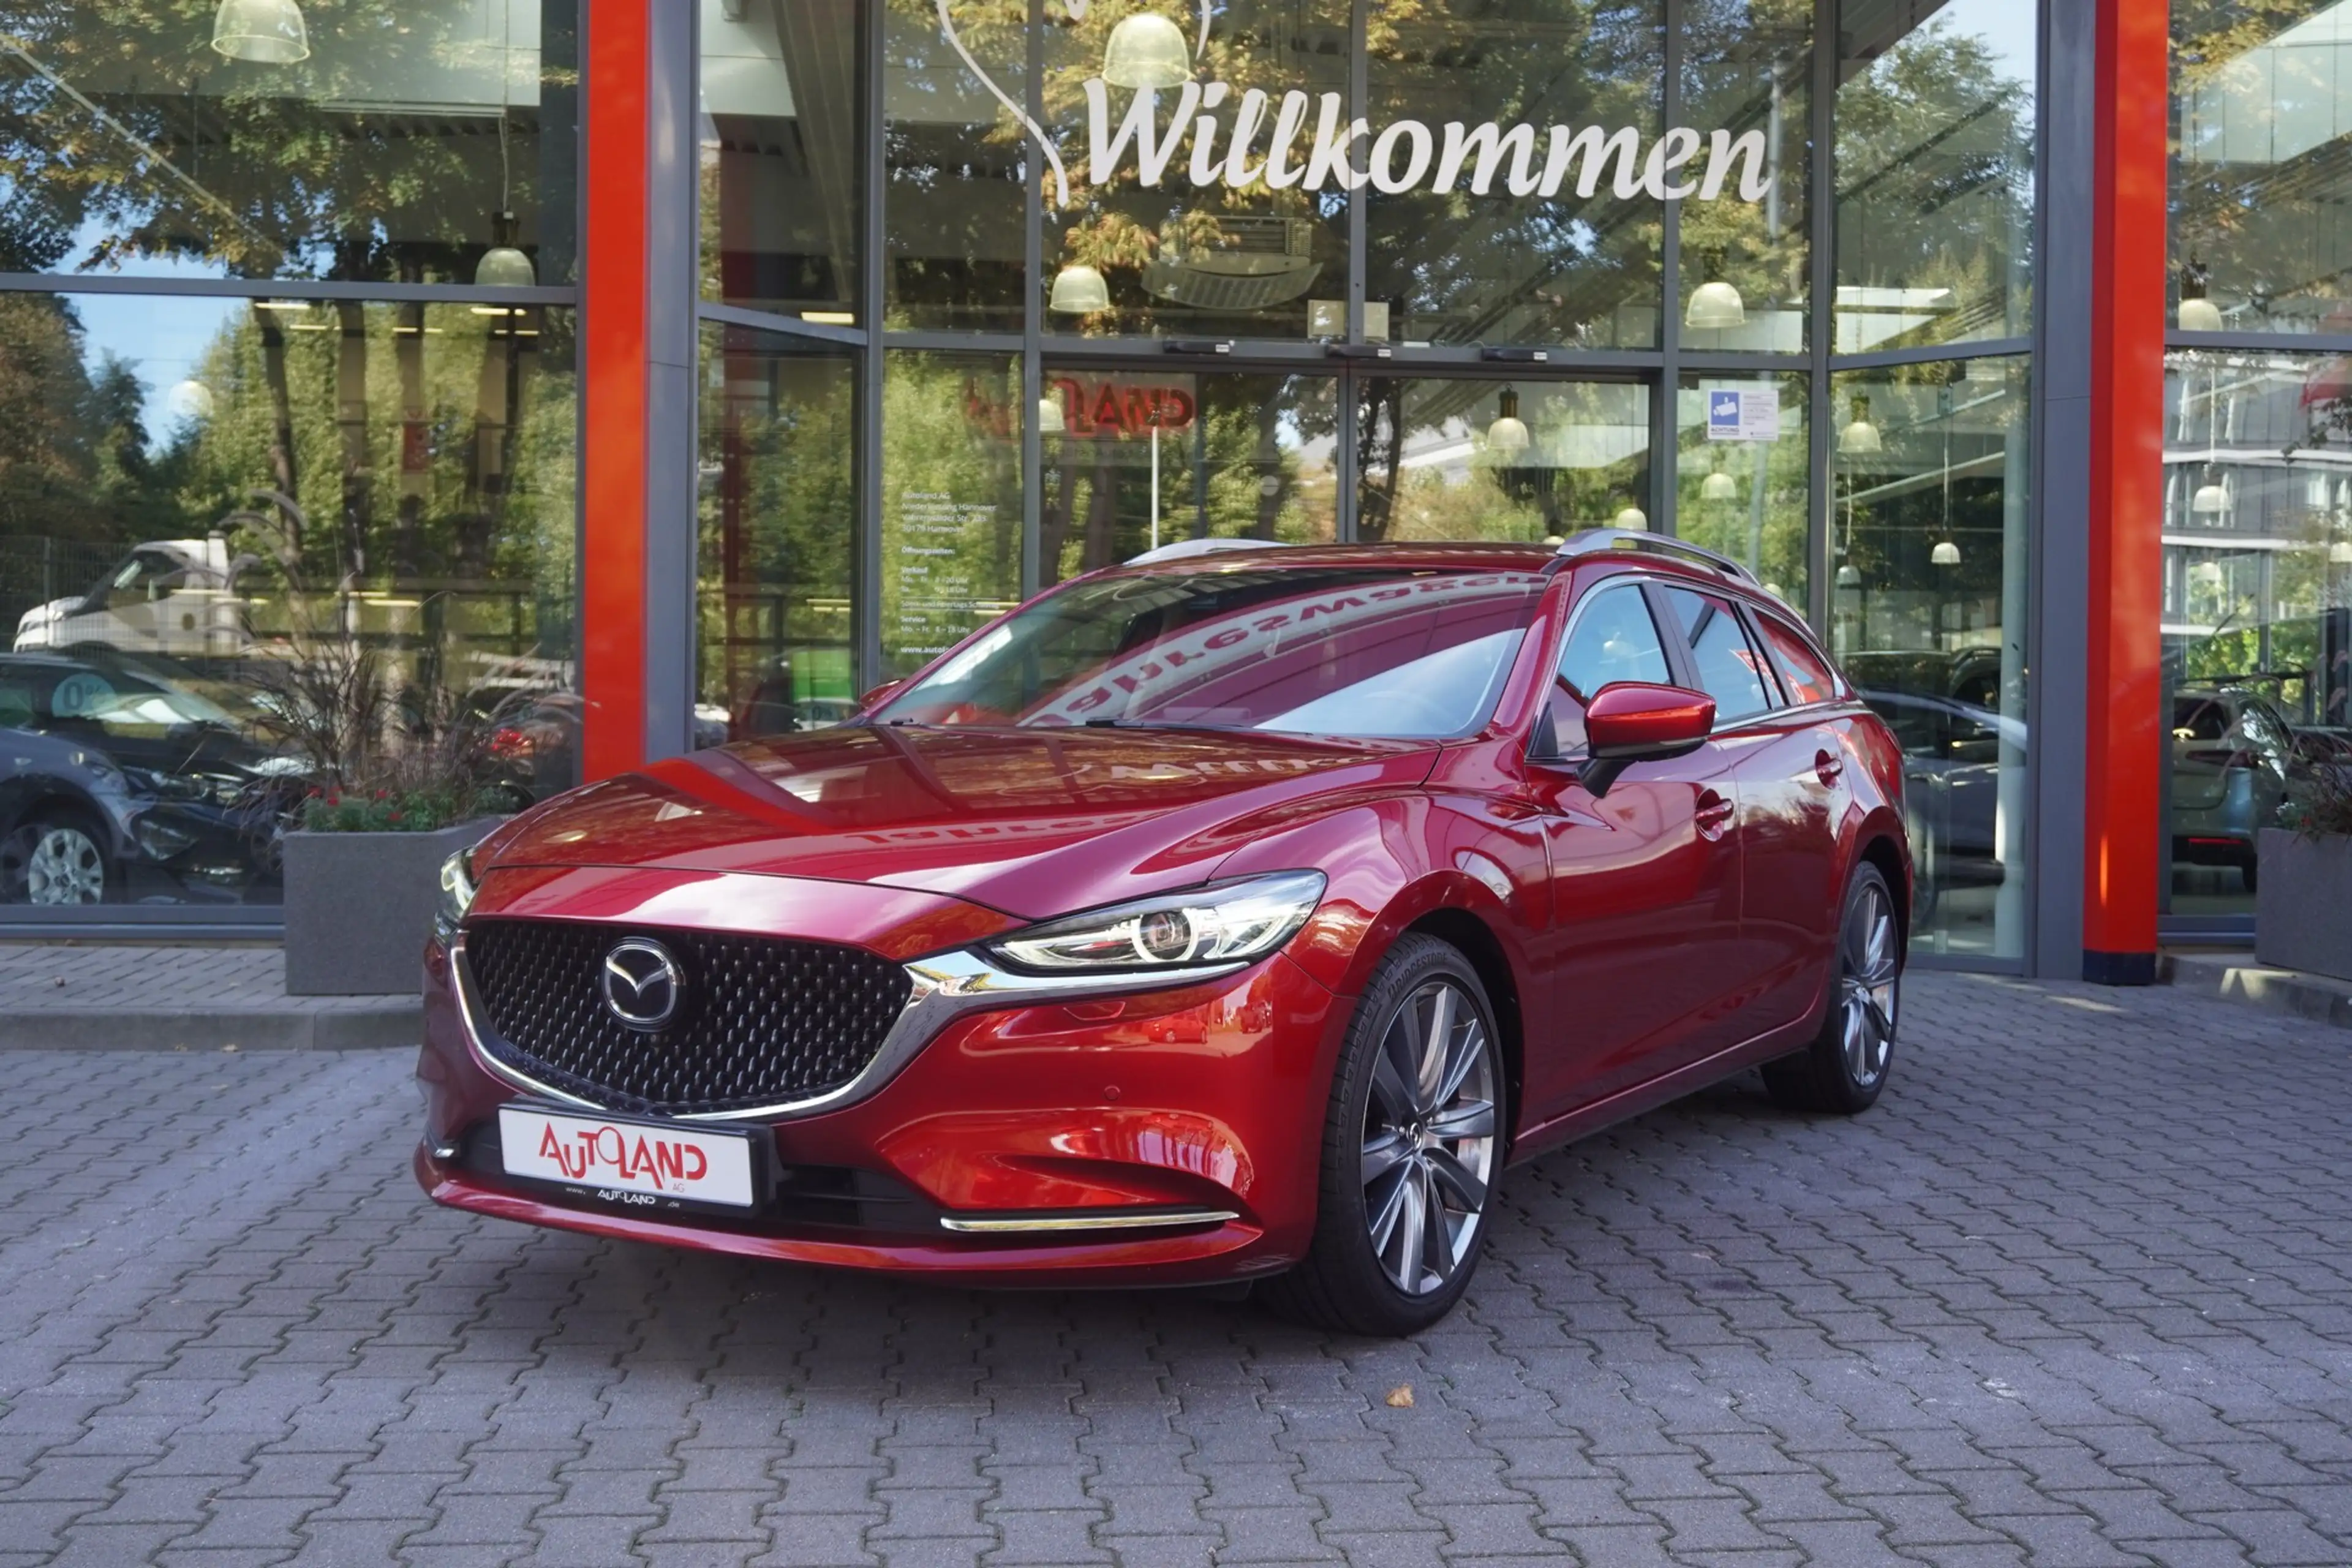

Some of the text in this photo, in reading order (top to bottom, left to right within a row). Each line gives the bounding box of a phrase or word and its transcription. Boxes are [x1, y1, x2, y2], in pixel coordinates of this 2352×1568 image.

[1082, 78, 1771, 202] Willkommen
[959, 503, 998, 512] Hannover
[927, 525, 965, 533] Hannover
[539, 1120, 707, 1189] AUTOLAND
[673, 1183, 685, 1193] AG
[597, 1189, 656, 1205] AUTOLAND
